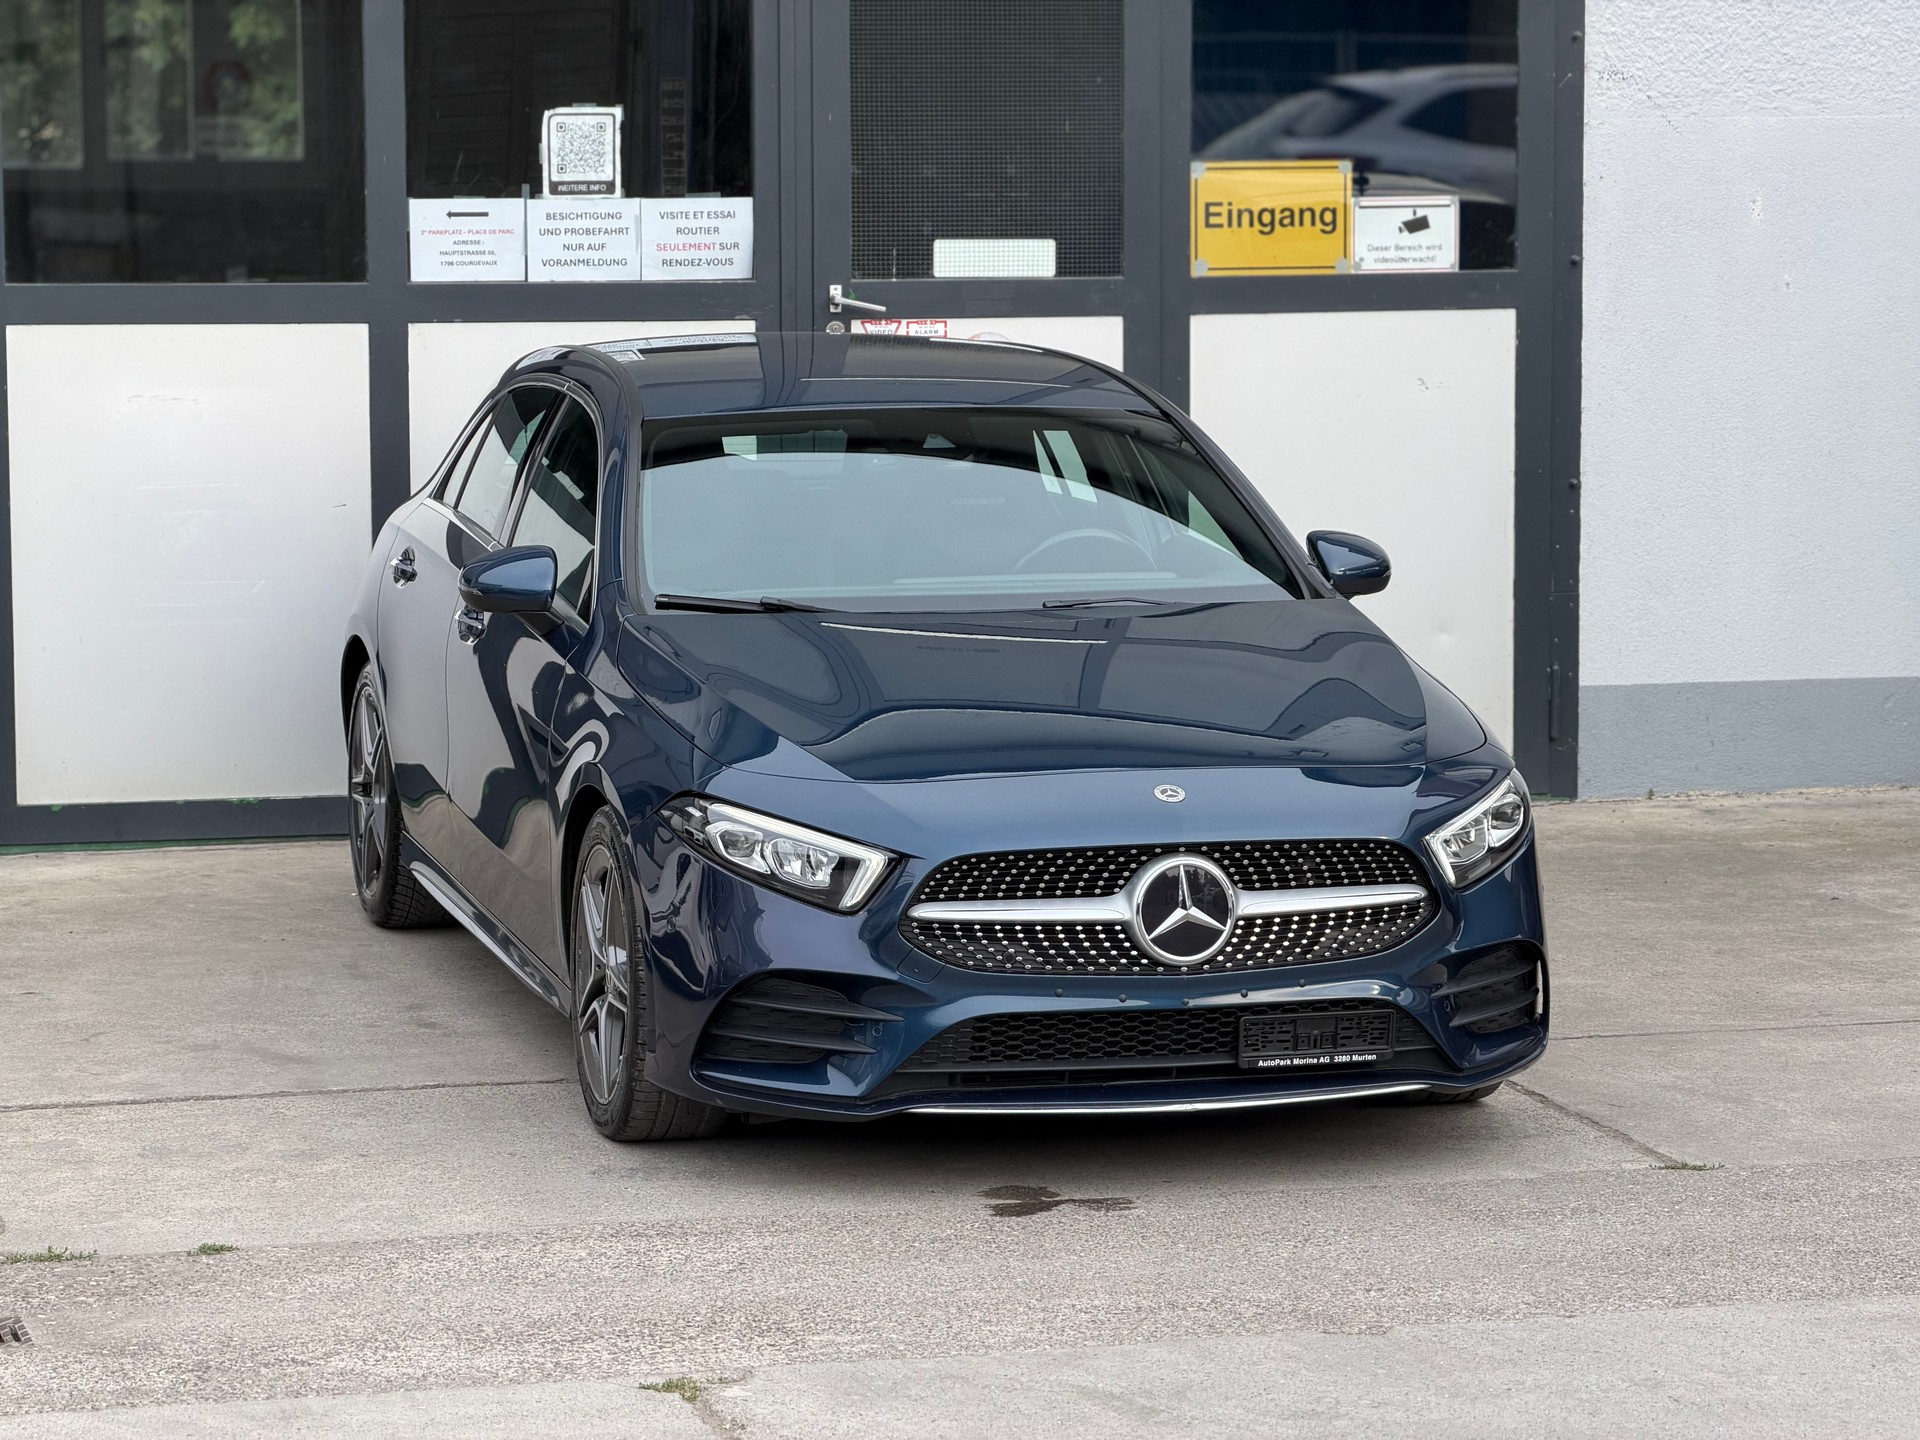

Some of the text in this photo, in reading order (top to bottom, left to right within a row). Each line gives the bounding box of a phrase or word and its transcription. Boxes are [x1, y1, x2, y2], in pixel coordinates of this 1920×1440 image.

[546, 212, 622, 220] BESICHTIGUNG
[659, 211, 736, 220] VISITE ET ESSAI
[1204, 202, 1337, 235] Eingang
[539, 227, 630, 236] UND PROBEFAHRT
[676, 227, 720, 235] ROUTIER
[563, 243, 607, 251] NUR AUF
[656, 242, 739, 251] SEULEMENT SUR
[1367, 244, 1392, 252] Dieser
[542, 258, 628, 267] VORANMELDUNG
[662, 258, 734, 267] RENDEZ-VOUS
